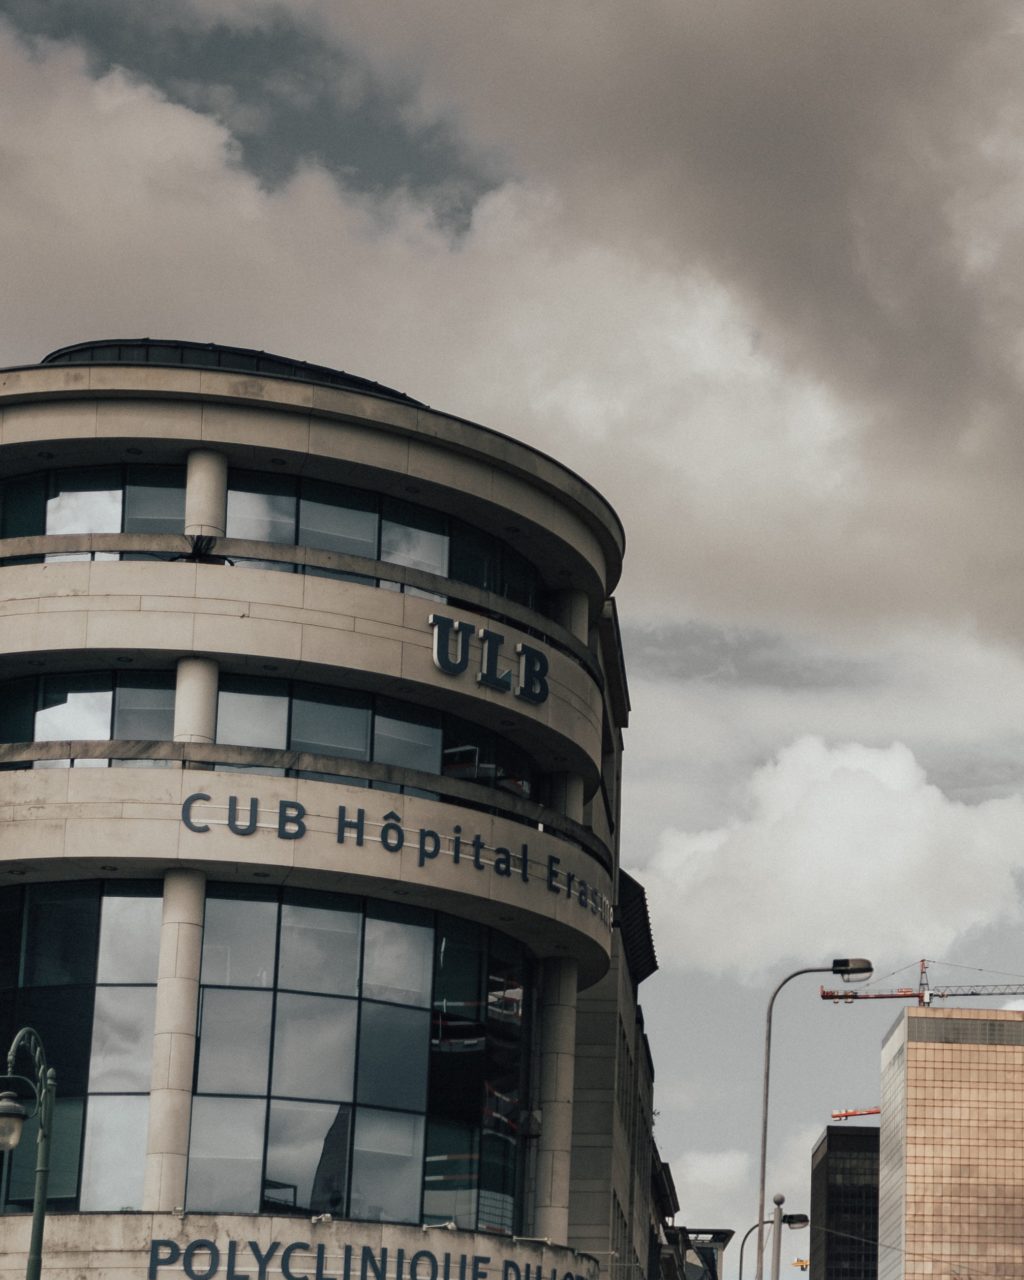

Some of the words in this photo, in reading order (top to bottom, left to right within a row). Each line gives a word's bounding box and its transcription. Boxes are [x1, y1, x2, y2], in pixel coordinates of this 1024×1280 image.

[429, 614, 549, 704] ULB
[182, 793, 307, 839] CUB
[337, 806, 529, 882] Hôpital
